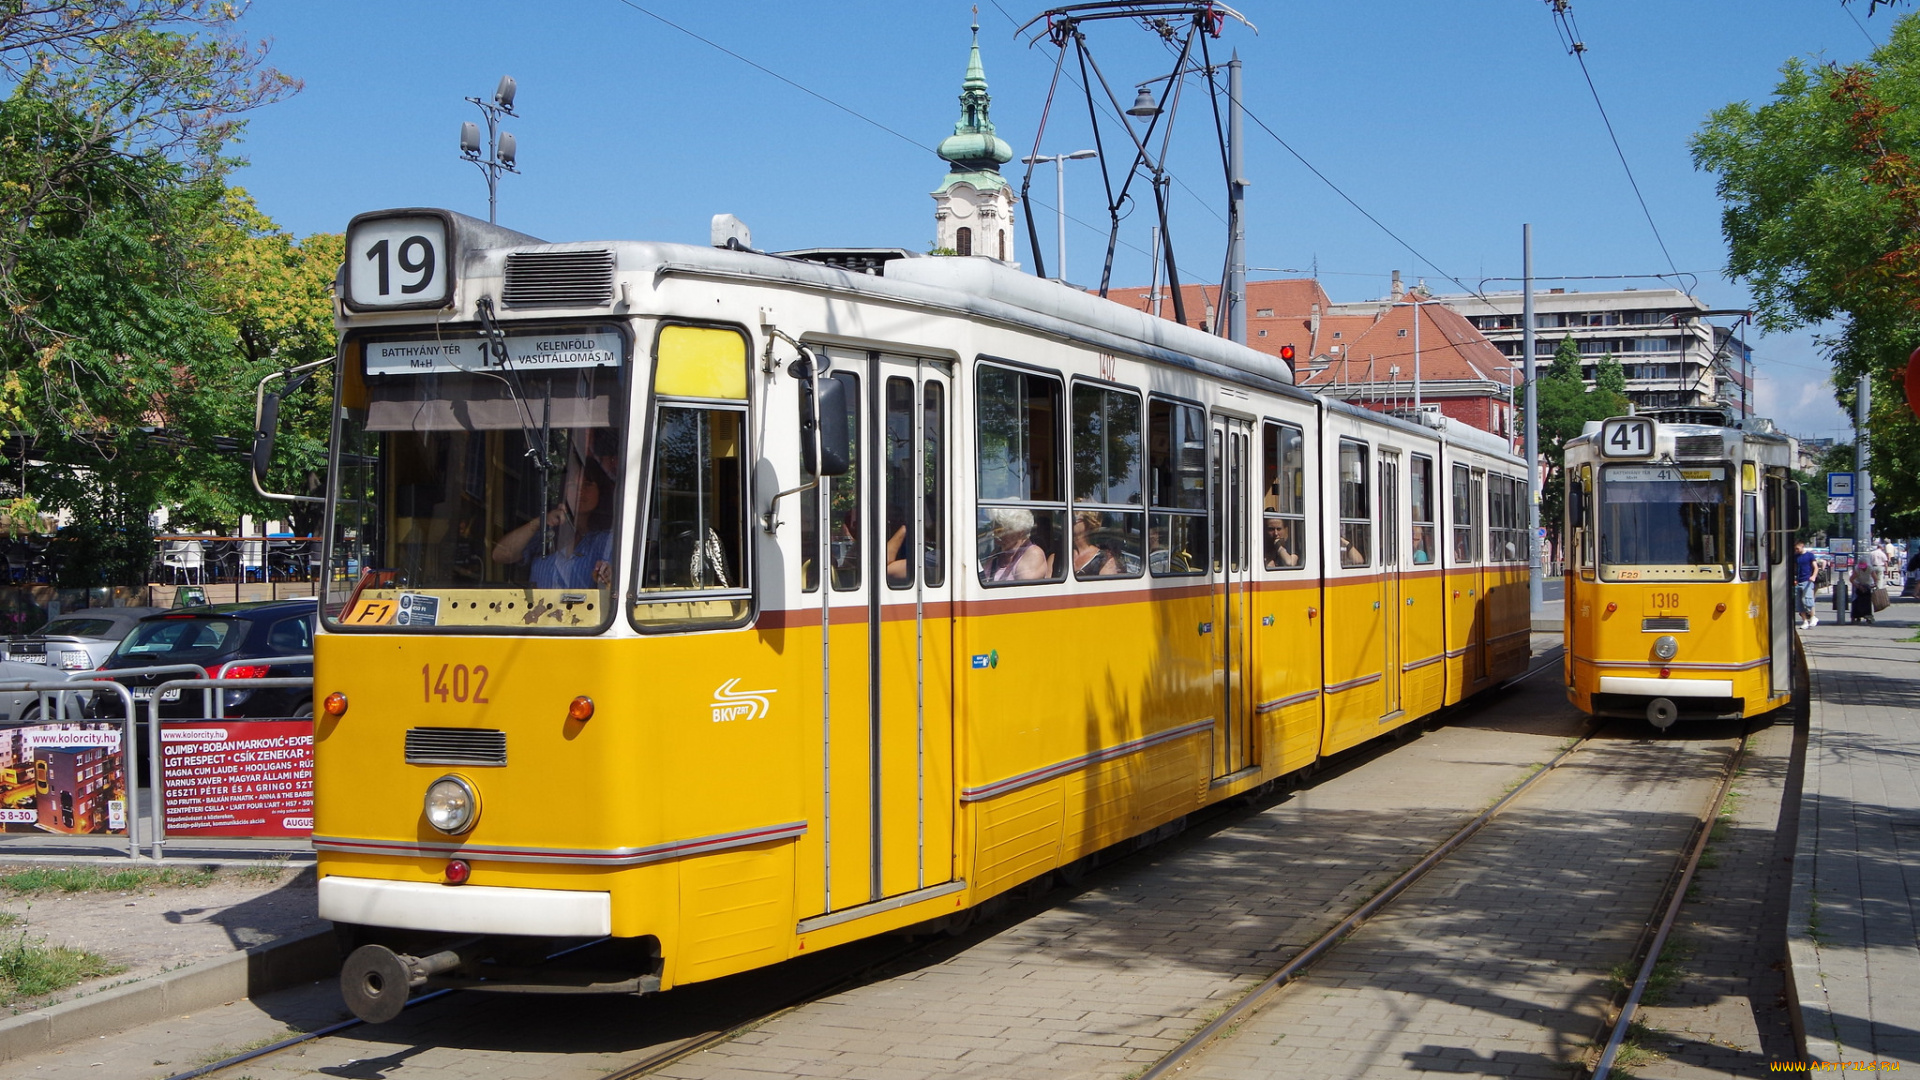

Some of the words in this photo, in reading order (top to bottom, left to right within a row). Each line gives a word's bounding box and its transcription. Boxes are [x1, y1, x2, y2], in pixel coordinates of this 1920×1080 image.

[366, 236, 436, 296] 19
[536, 340, 594, 352] KELENFÖLD
[382, 346, 439, 358] BATTHYÁNY
[442, 345, 461, 355] TÉR
[518, 352, 600, 364] VASÚTÁLLOMÁS
[604, 352, 614, 361] M
[410, 359, 433, 368] M+H
[1610, 424, 1645, 450] 41
[1658, 470, 1671, 479] 41
[1652, 593, 1679, 608] 1318
[357, 604, 390, 622] F1
[422, 664, 490, 704] 1402
[33, 734, 116, 744] www.kolorcity.hu
[164, 730, 224, 740] www.kolorcity.hu
[164, 744, 198, 756] QUIMBY
[203, 741, 236, 752] BOBAN
[236, 735, 284, 750] MARKOVIĆ
[165, 758, 182, 768] LGT
[184, 754, 225, 766] RESPECT
[233, 751, 255, 763] CSÍK
[257, 749, 304, 761] ZENEKAR
[166, 768, 193, 778] MAGNA
[194, 768, 210, 776] CUM
[212, 766, 238, 774] LAUDE
[245, 762, 292, 773] HOOLIGANS
[166, 779, 196, 787] VARNUS
[197, 777, 222, 785] XAVER
[229, 774, 260, 783] MAGYAR
[262, 771, 292, 781] ÁLLAMI
[294, 769, 312, 779] NÉPI
[166, 788, 197, 798] GESZTI
[200, 786, 228, 795] PÉTER
[232, 784, 242, 793] ÉS
[256, 782, 292, 792] GRINGO
[206, 795, 229, 803] BALKÁN
